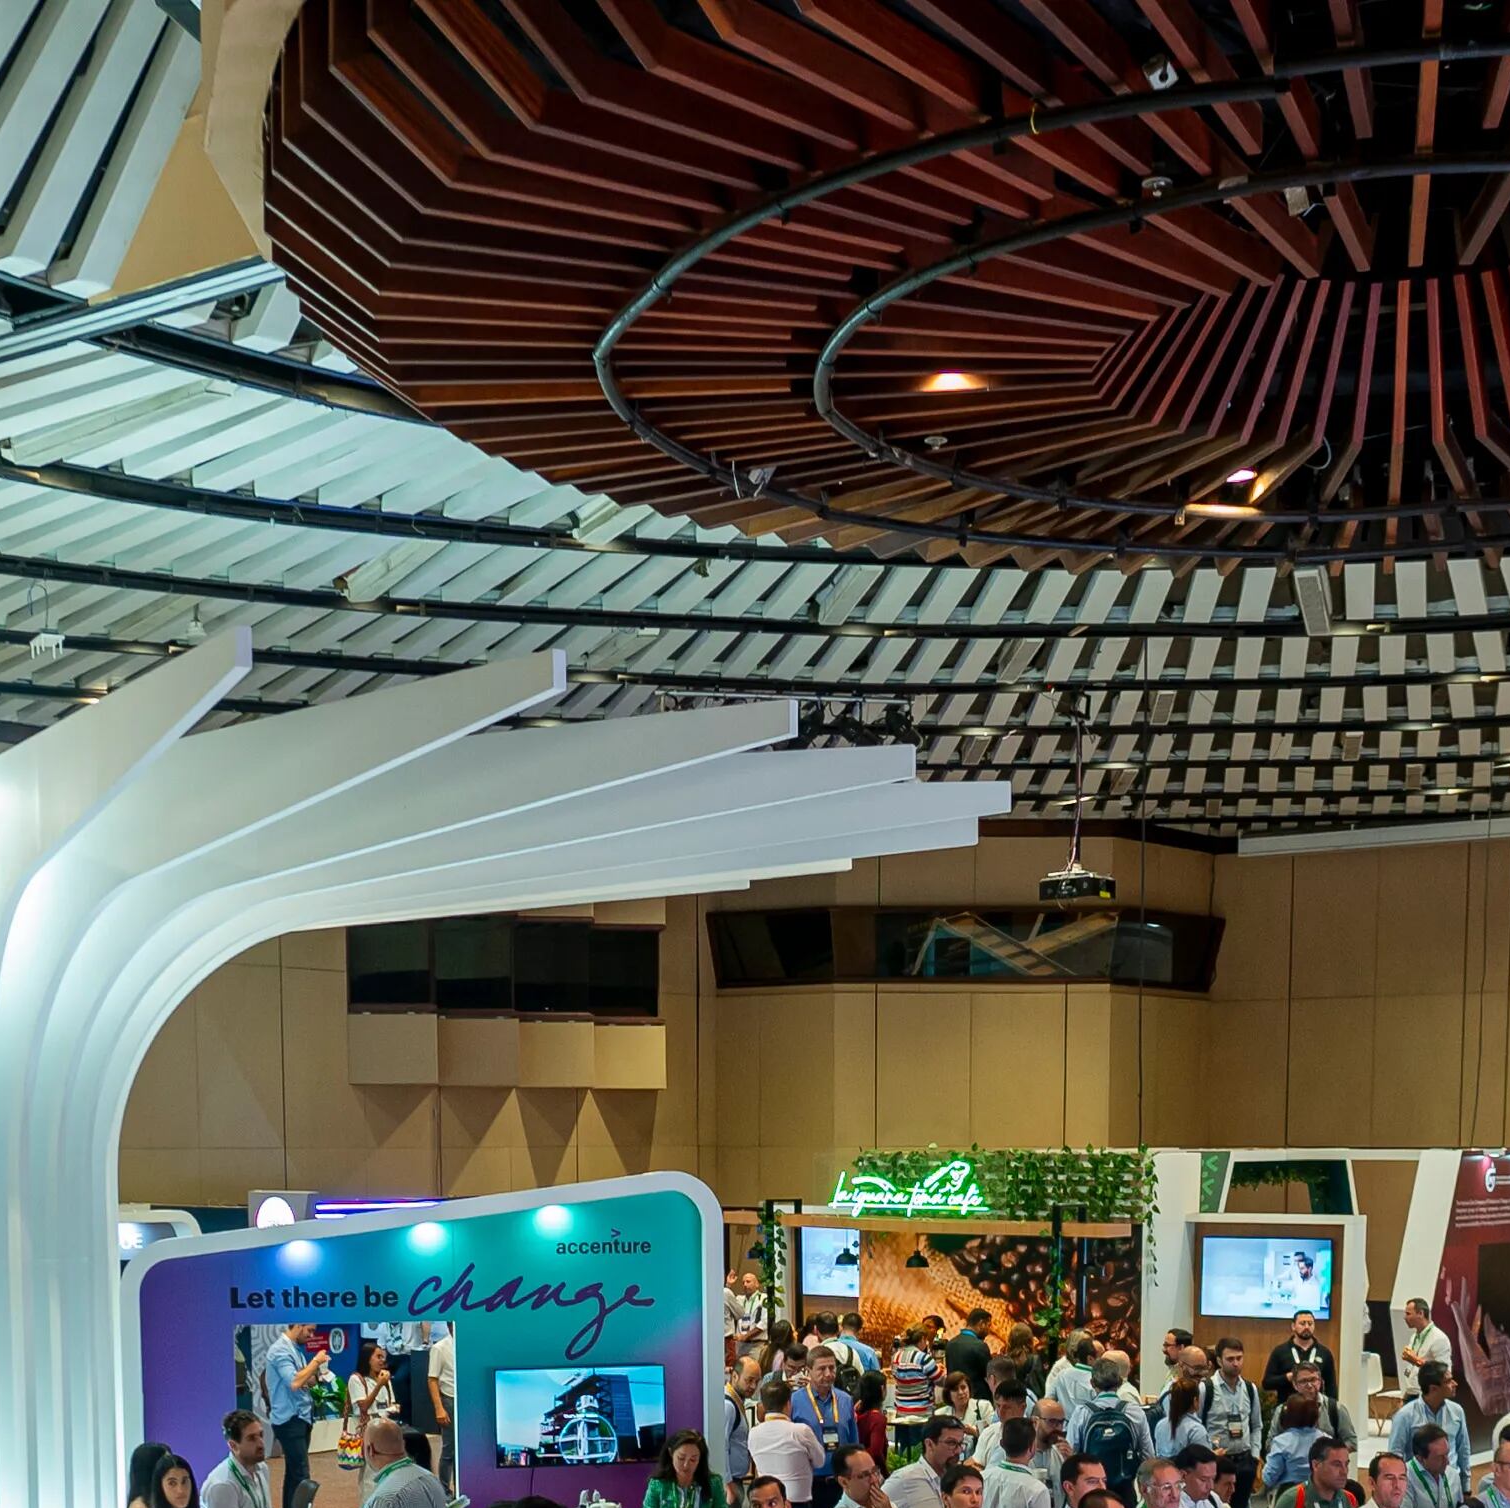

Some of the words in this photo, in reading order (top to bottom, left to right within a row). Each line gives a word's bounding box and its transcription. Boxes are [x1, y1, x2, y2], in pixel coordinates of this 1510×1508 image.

[555, 1236, 652, 1256] accenture
[229, 1286, 276, 1309] Let
[281, 1284, 358, 1308] there
[363, 1284, 399, 1308] be
[407, 1262, 656, 1361] change
